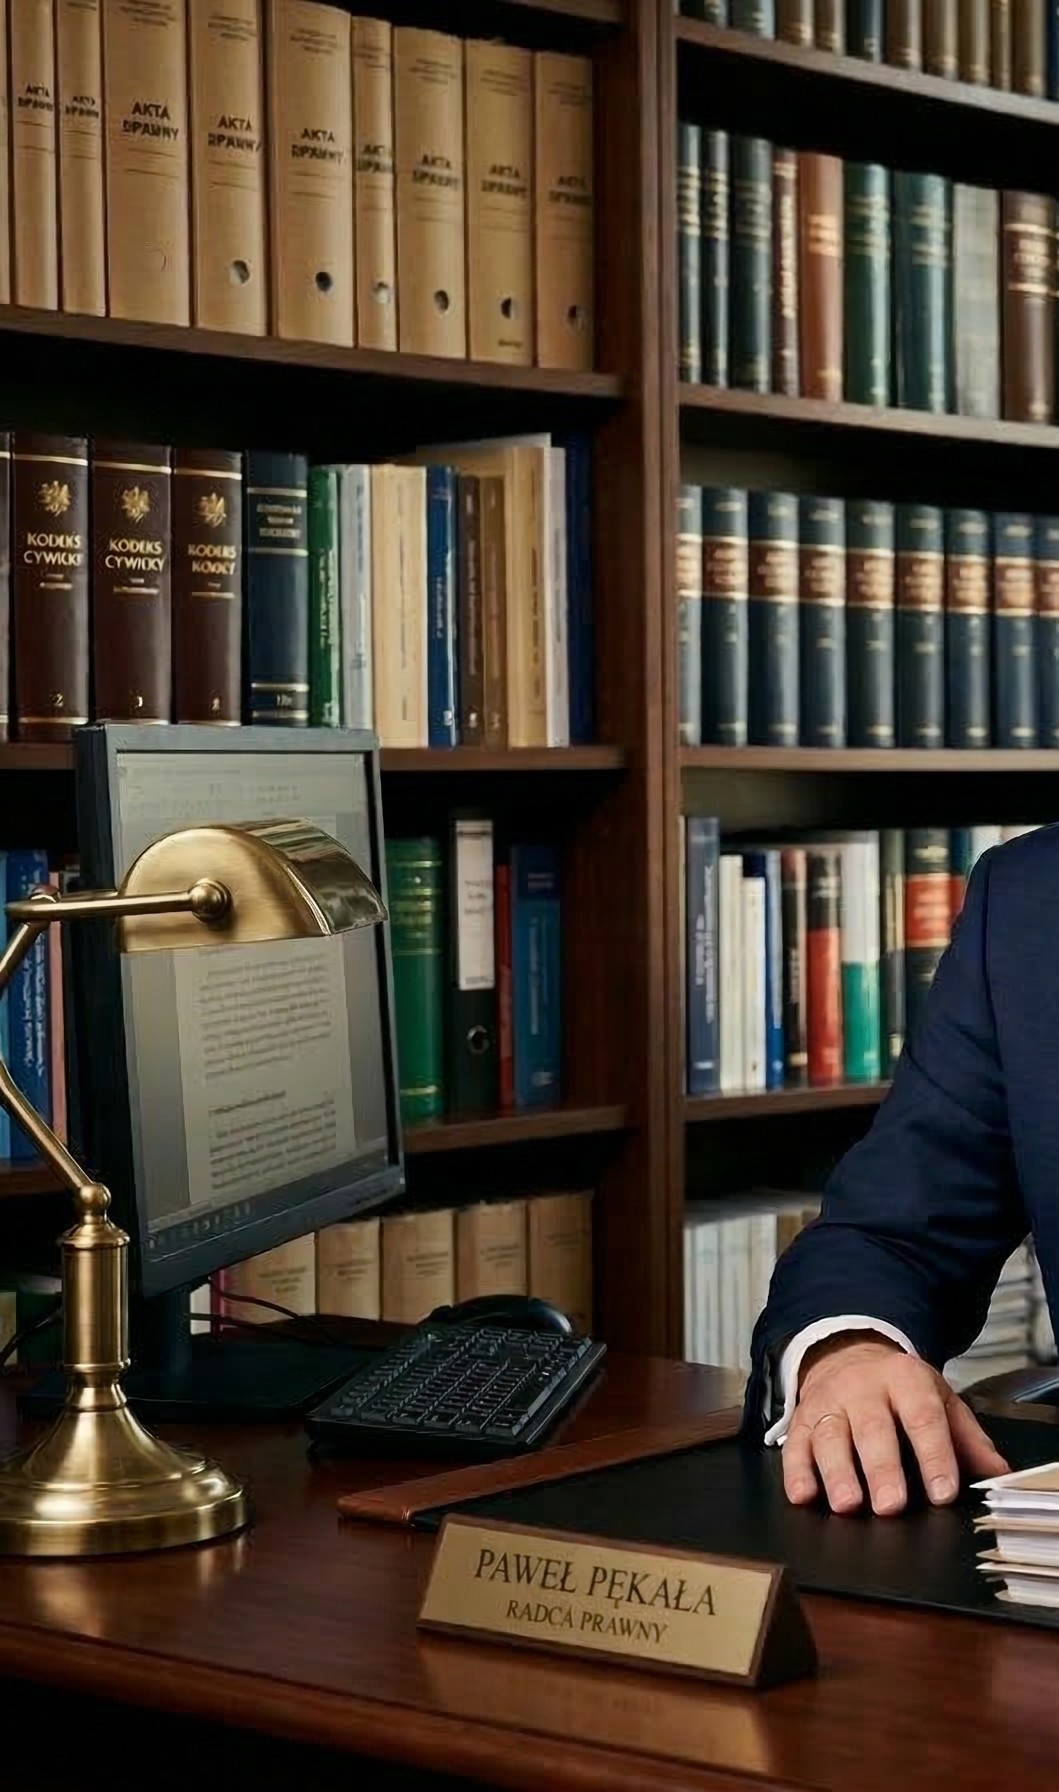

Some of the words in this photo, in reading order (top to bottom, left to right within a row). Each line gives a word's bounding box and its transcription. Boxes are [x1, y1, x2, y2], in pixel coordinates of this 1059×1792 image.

[131, 101, 171, 121] AKTA
[217, 113, 252, 132] AKTA
[301, 127, 335, 143] AKTA
[474, 1548, 578, 1595] PAWEŁ
[586, 1564, 718, 1617] PĘKAŁA
[505, 1599, 575, 1629] RADCA
[579, 1610, 670, 1645] PRAWNY
